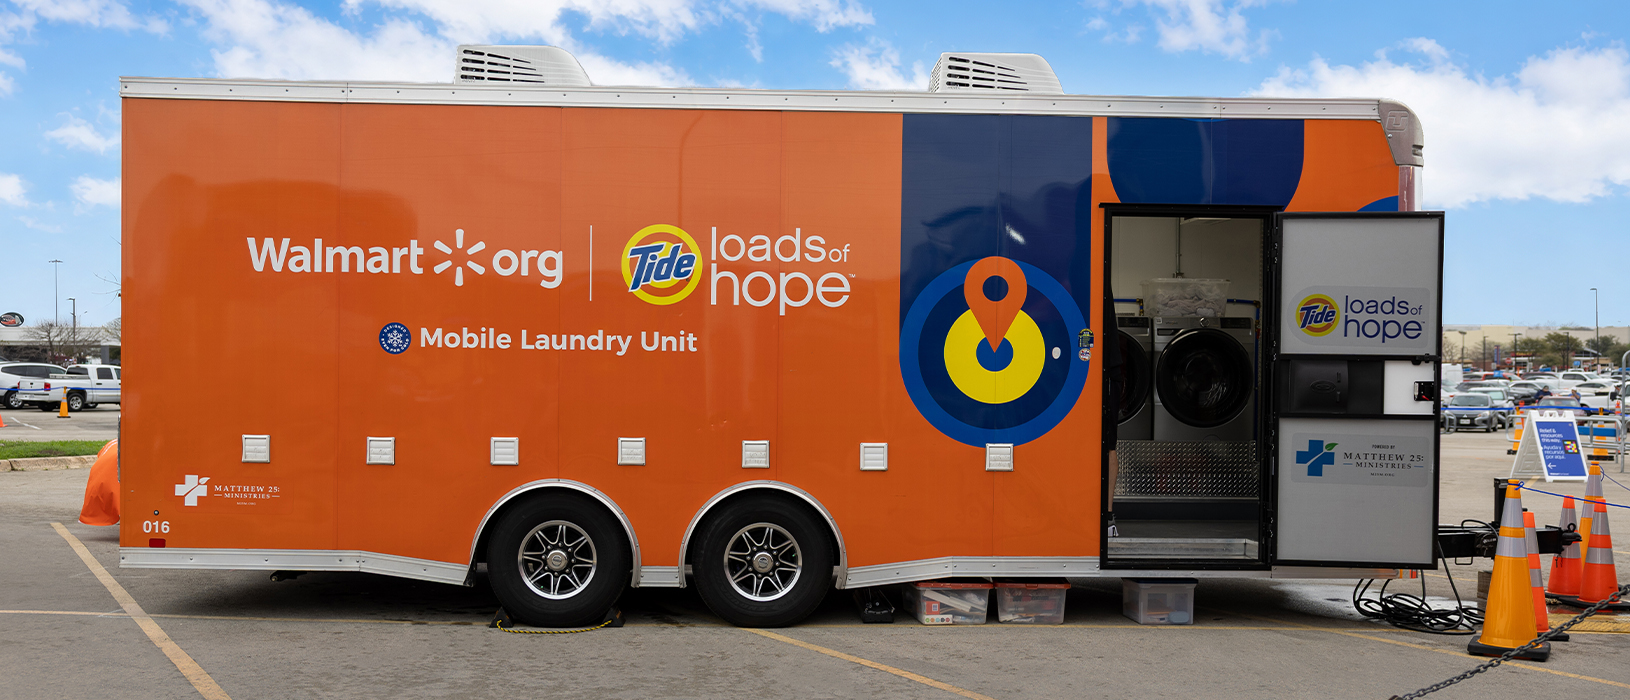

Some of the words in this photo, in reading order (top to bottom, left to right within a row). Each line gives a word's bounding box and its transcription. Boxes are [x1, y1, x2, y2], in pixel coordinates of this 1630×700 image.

[711, 226, 826, 263] loads
[828, 243, 850, 263] of
[246, 237, 424, 274] Walmart
[492, 249, 563, 289] org
[627, 242, 697, 293] Tide
[710, 263, 851, 316] hope
[1299, 303, 1337, 329] Tide
[1344, 295, 1409, 315] loads
[1410, 304, 1423, 316] of
[420, 327, 512, 349] Mobile
[521, 329, 633, 356] Laundry
[641, 330, 698, 352] Unit
[1343, 315, 1423, 343] hope
[1343, 452, 1405, 461] MATTHEW
[1409, 454, 1424, 462] 25:
[142, 520, 170, 533] 016
